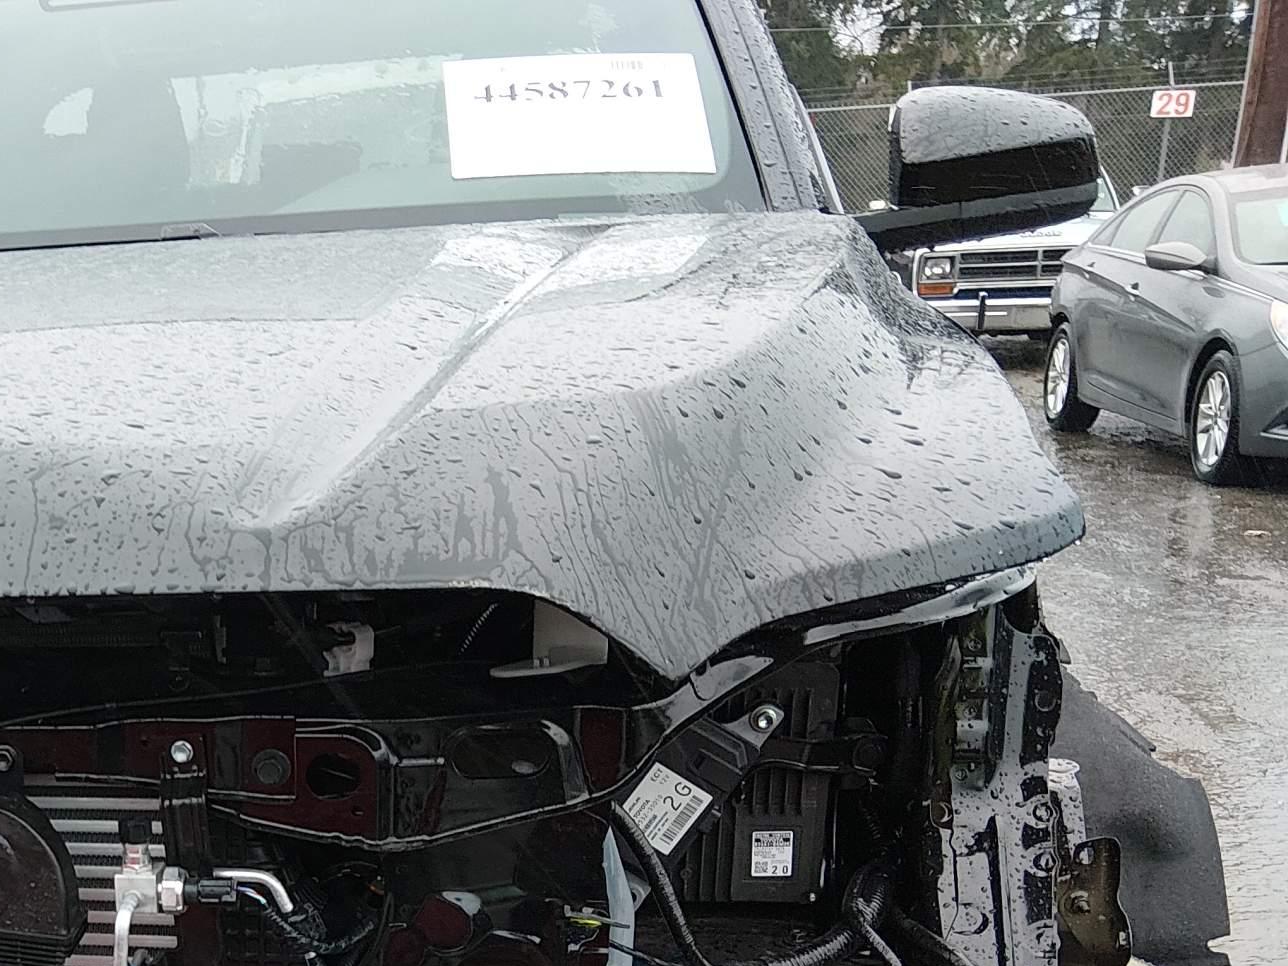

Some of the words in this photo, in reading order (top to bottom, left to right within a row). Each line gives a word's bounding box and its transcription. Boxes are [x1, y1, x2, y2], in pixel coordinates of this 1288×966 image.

[474, 79, 665, 103] 44587261
[1156, 92, 1190, 116] 29
[633, 799, 650, 819] TOYOTA
